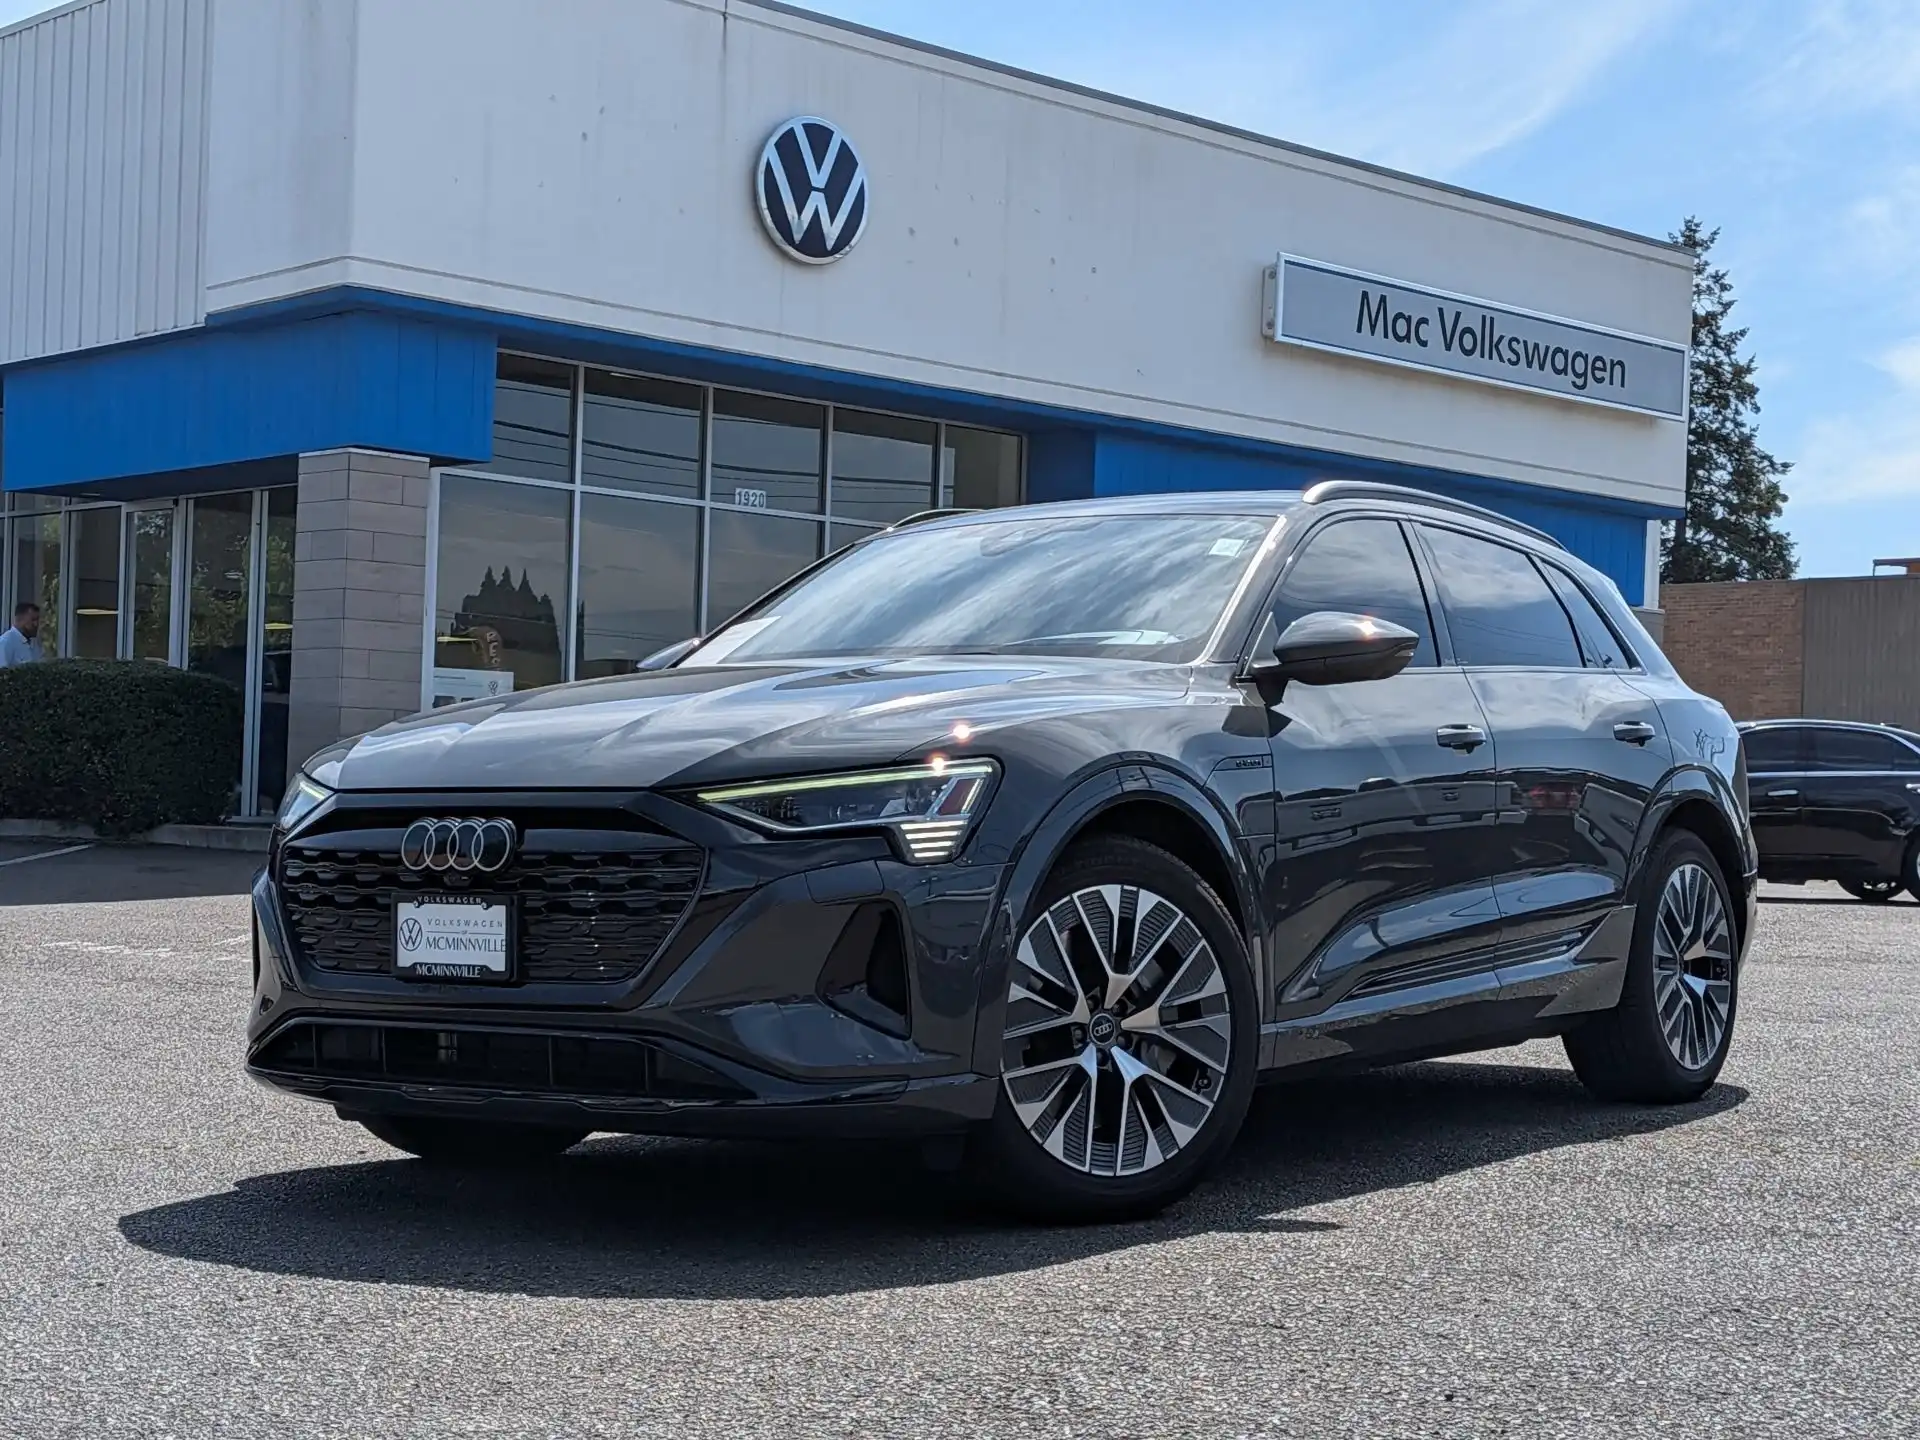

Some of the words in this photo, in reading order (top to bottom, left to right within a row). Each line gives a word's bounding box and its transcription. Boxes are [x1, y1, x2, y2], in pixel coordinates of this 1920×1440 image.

[1355, 290, 1430, 348] Mac
[1437, 306, 1626, 391] Volkswagen
[736, 490, 765, 507] 1920
[417, 896, 482, 904] VOLKSWAGEN
[427, 918, 503, 928] VOLKSWAGEN
[425, 936, 507, 953] MCMINNVILLE
[416, 963, 481, 978] MCMINNVILLE
